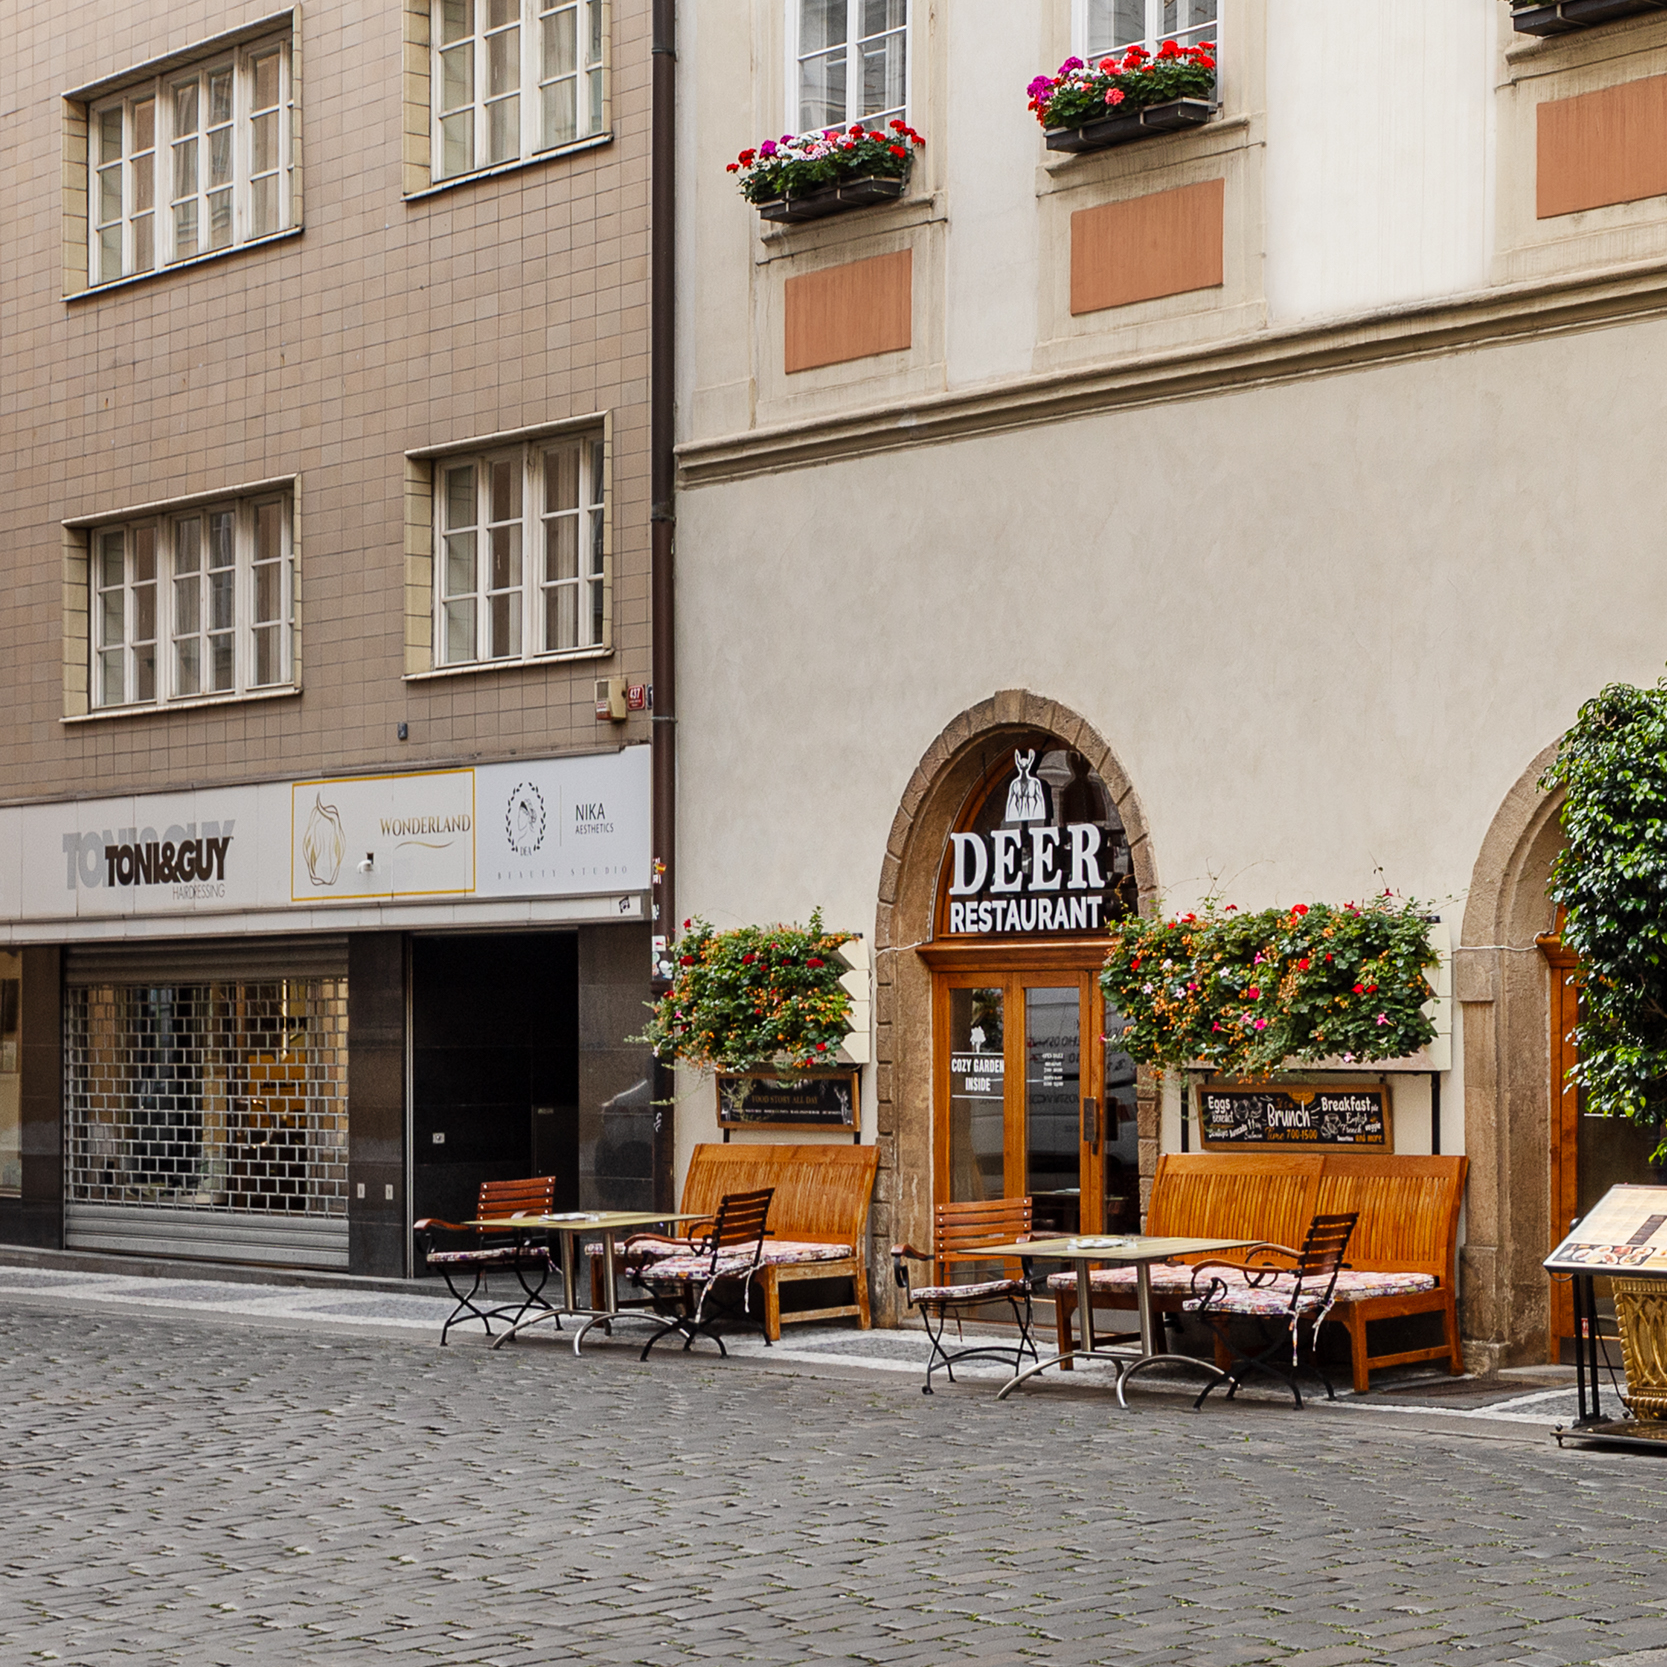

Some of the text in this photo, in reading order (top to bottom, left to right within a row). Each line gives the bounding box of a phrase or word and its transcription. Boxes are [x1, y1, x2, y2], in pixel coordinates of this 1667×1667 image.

[575, 803, 606, 822] NIKA
[379, 814, 471, 837] WONDERLAND
[575, 823, 614, 835] AESTHETICS
[105, 836, 231, 887] TONI&GUY
[948, 823, 1105, 895] DEER
[498, 866, 628, 880] BEAUTY STUDIO
[172, 884, 225, 900] HAIRDRESSING
[950, 896, 1103, 933] RESTAURANT
[951, 1058, 1005, 1074] COZY GARDEN
[965, 1077, 991, 1092] INSIDE
[1207, 1095, 1231, 1114] Eggs
[1267, 1100, 1311, 1127] Brunch
[1321, 1096, 1371, 1112] Breakfast
